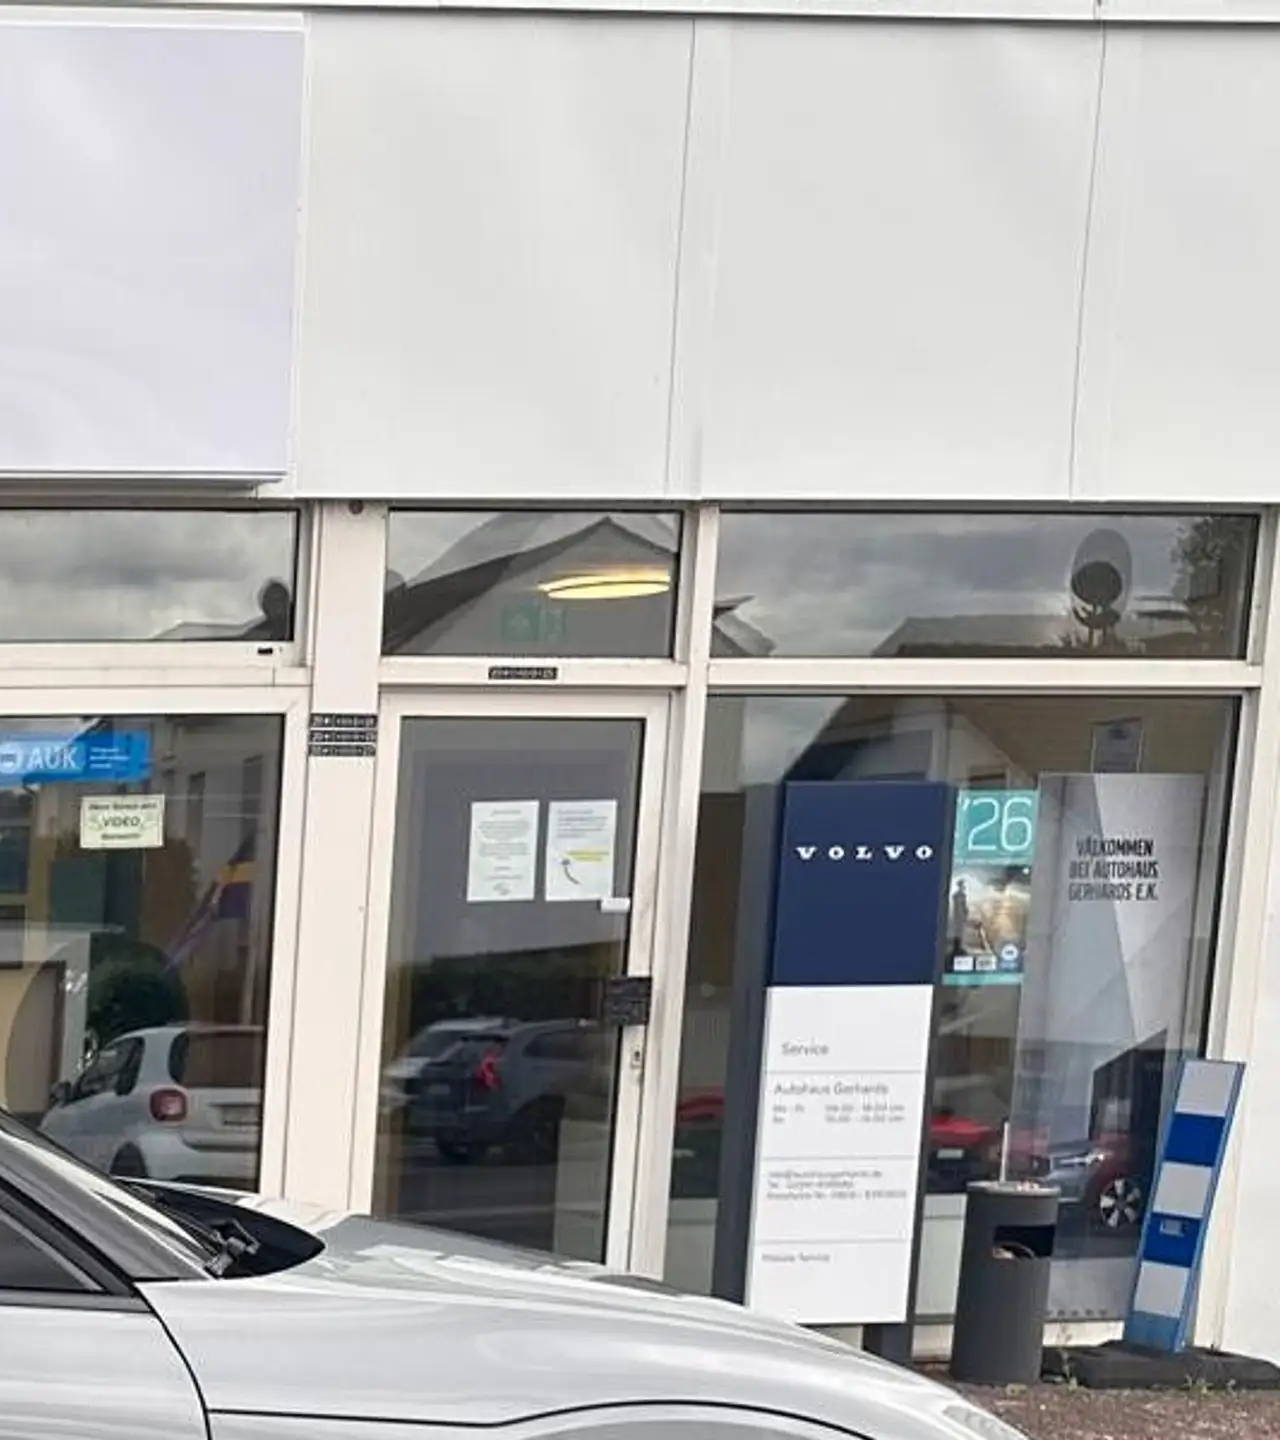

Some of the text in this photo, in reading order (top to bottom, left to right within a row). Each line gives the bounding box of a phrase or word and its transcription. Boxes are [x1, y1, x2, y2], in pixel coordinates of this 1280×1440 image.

[796, 844, 933, 860] VOLVO
[1092, 860, 1159, 879] AUTOHAUS
[782, 1040, 829, 1056] Service
[774, 1080, 889, 1096] Autohaus Gerhards
